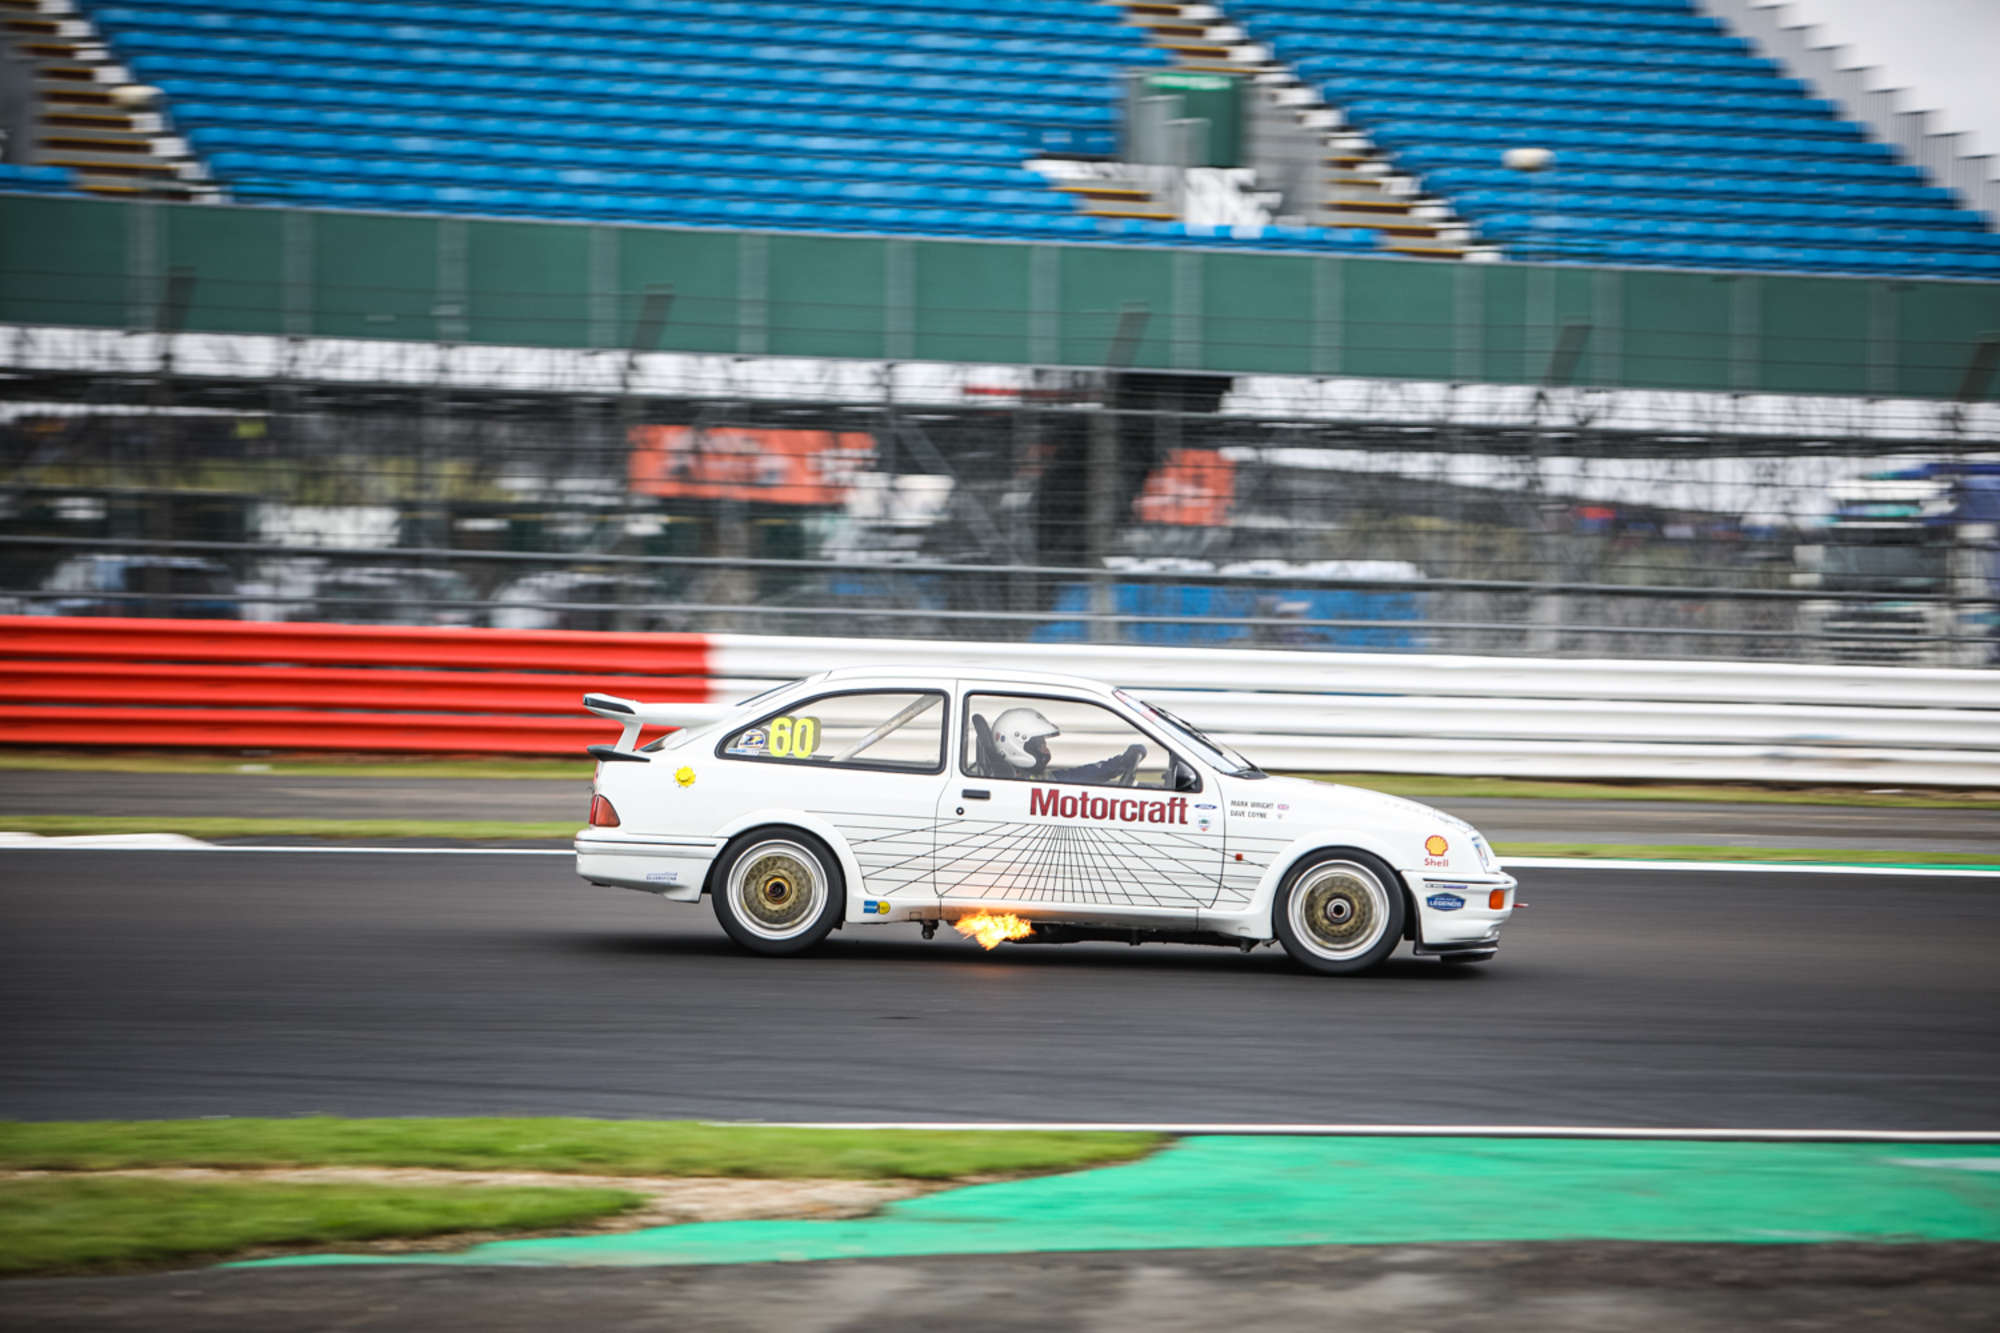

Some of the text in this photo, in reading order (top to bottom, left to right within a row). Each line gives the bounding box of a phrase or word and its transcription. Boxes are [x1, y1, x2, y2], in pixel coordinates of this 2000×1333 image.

[769, 716, 814, 758] 60
[1030, 788, 1188, 824] Motorcraft
[1424, 857, 1449, 867] Shell
